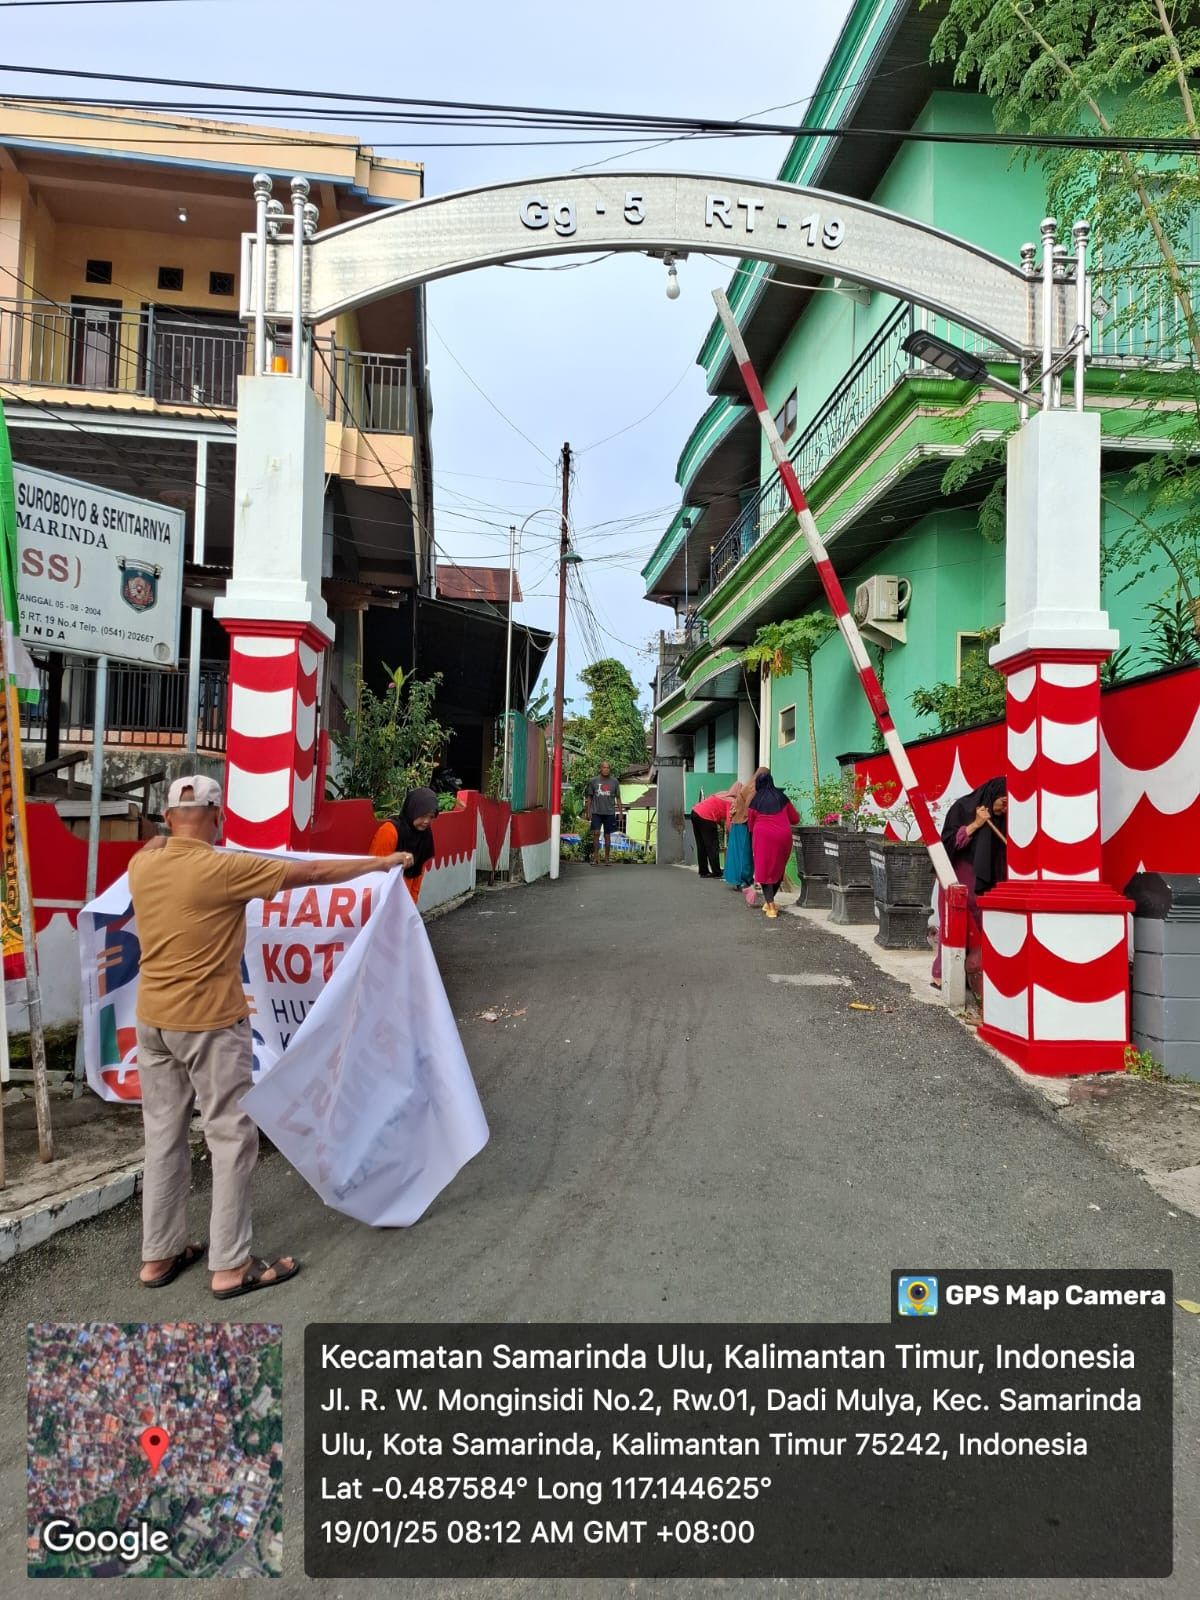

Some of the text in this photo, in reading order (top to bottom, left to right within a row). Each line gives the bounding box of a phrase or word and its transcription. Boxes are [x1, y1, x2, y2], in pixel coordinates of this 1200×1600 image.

[519, 194, 578, 236] Gg
[623, 192, 646, 224] 5
[704, 194, 764, 232] RT
[800, 213, 845, 249] 19
[18, 483, 171, 544] SUROBOYO & SEKITARNYA
[16, 592, 54, 607] TANGGAL
[55, 600, 65, 609] 05
[84, 606, 102, 616] 2004
[28, 611, 42, 622] RT.
[45, 615, 55, 624] 19
[80, 621, 99, 635] Telp.
[101, 626, 126, 640] (0541)
[261, 887, 373, 928] HARI
[271, 998, 316, 1025] HU
